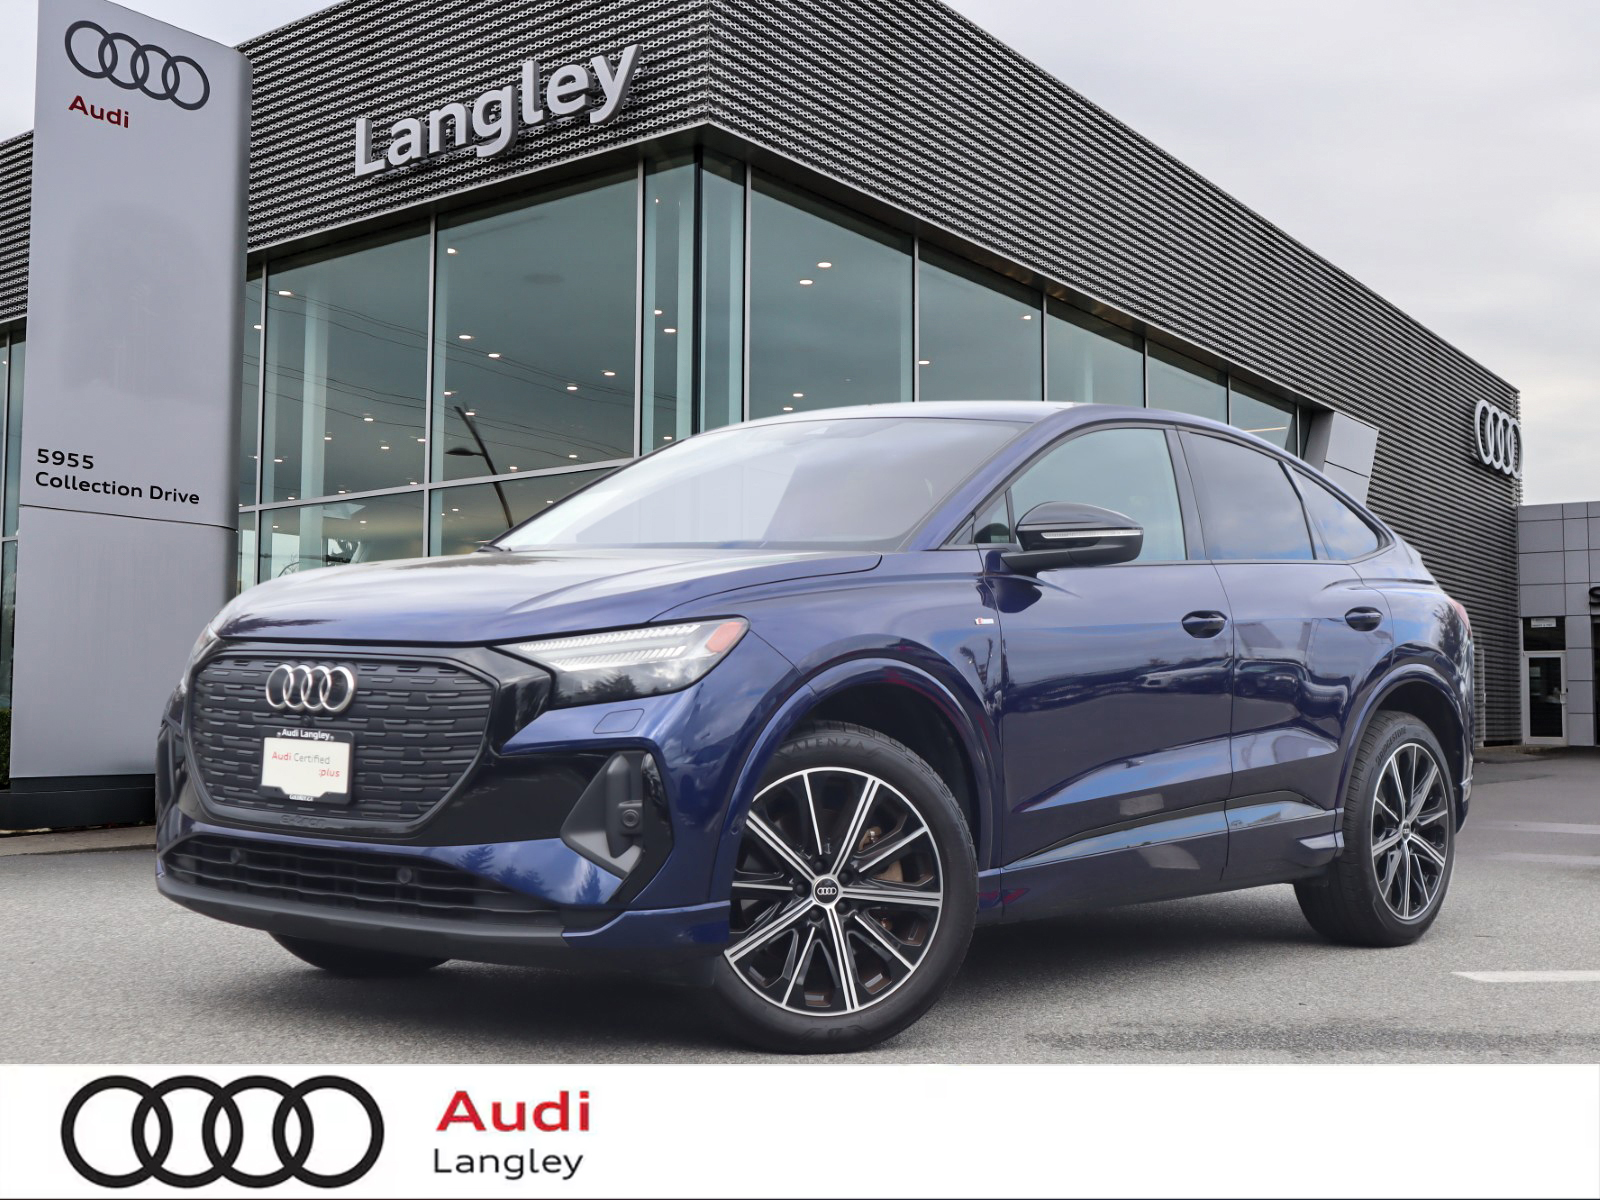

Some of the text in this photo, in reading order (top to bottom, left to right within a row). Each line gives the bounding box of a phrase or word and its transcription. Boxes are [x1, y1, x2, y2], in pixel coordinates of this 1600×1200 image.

[69, 95, 129, 128] Audi
[355, 44, 642, 176] Langley
[37, 448, 94, 469] 5955
[35, 471, 200, 504] Collection Drive
[282, 729, 331, 741] Audi Langley
[272, 752, 331, 765] Audi Certified
